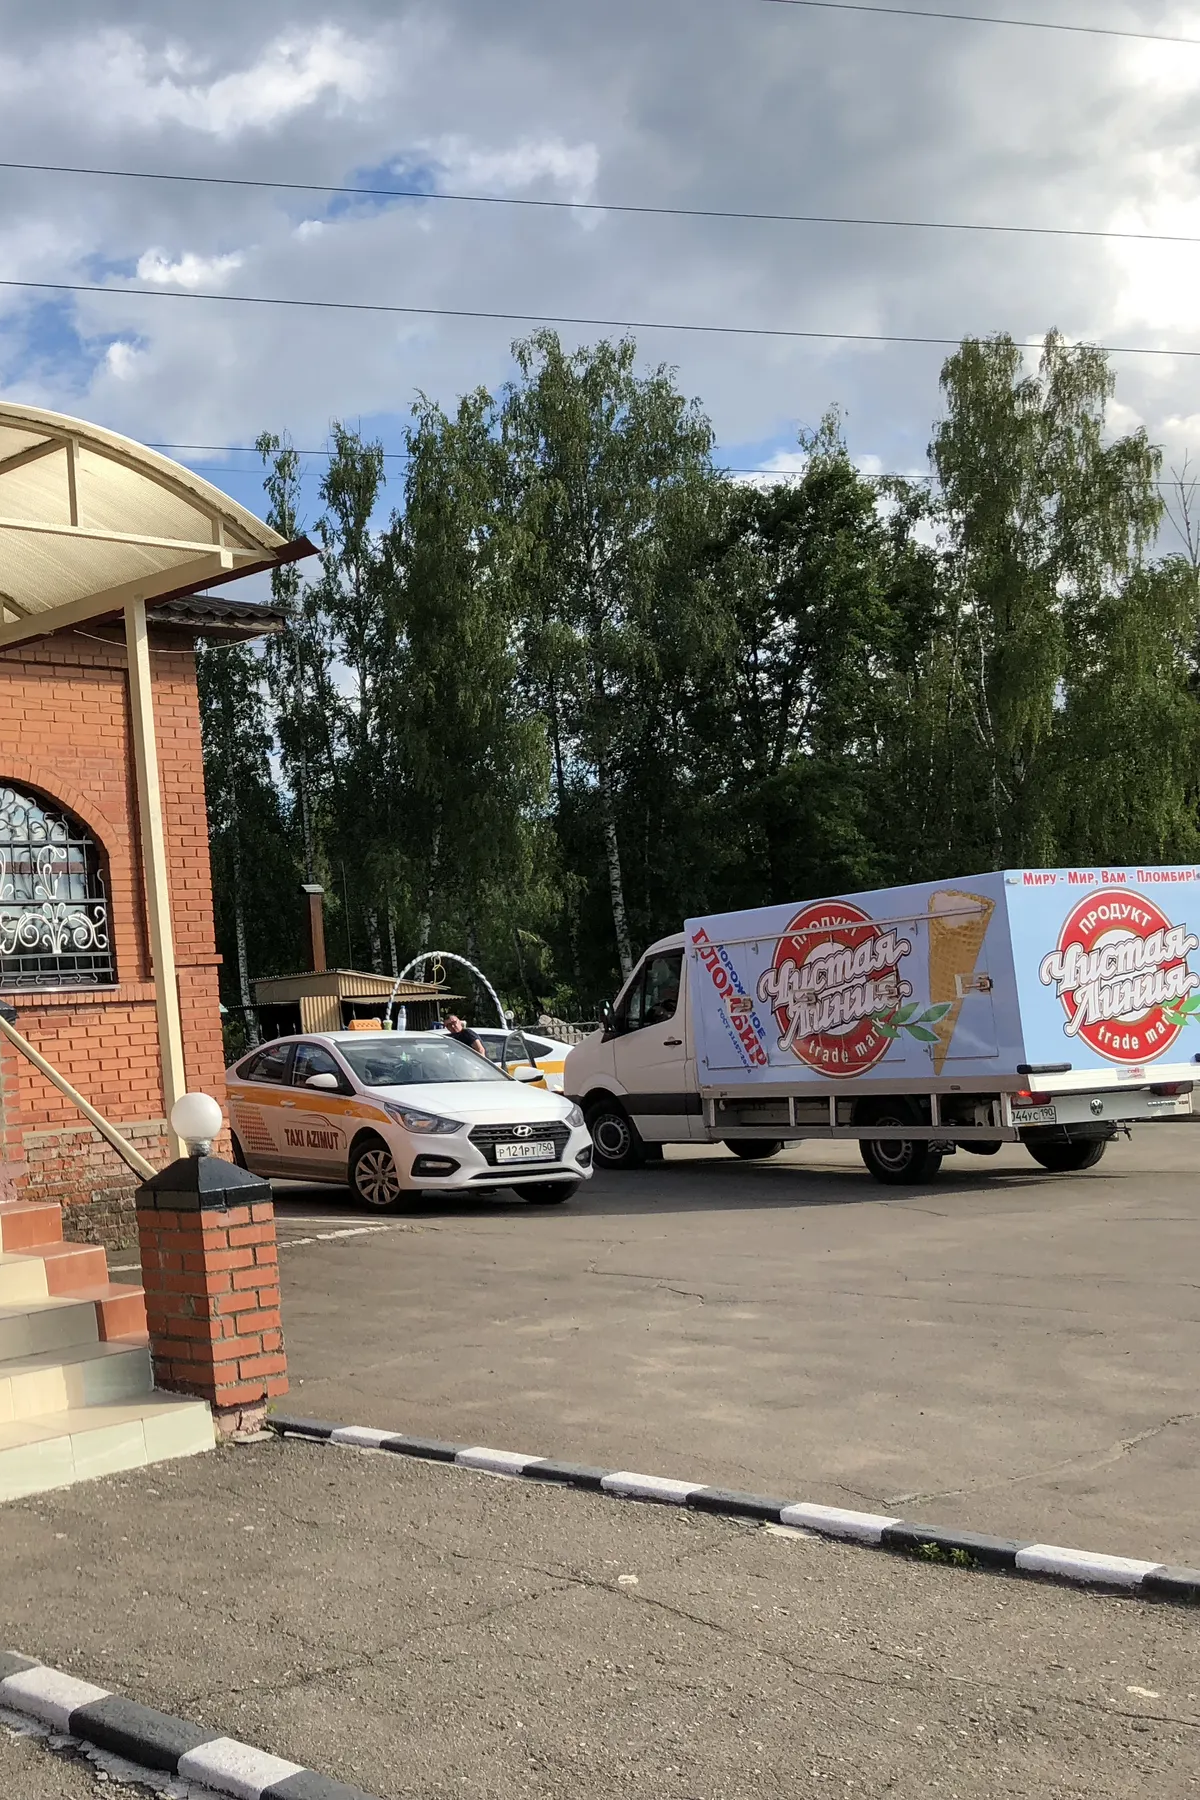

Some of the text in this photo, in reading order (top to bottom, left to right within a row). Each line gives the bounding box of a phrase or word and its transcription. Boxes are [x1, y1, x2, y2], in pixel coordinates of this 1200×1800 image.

[1078, 903, 1152, 935] ПРОДУКТ
[1039, 924, 1199, 998] Чистая
[1063, 962, 1200, 1037] Линия
[808, 1018, 886, 1063] trade mark
[1097, 1005, 1176, 1050] trade mark
[284, 1128, 339, 1150] TAXI AZIMUT
